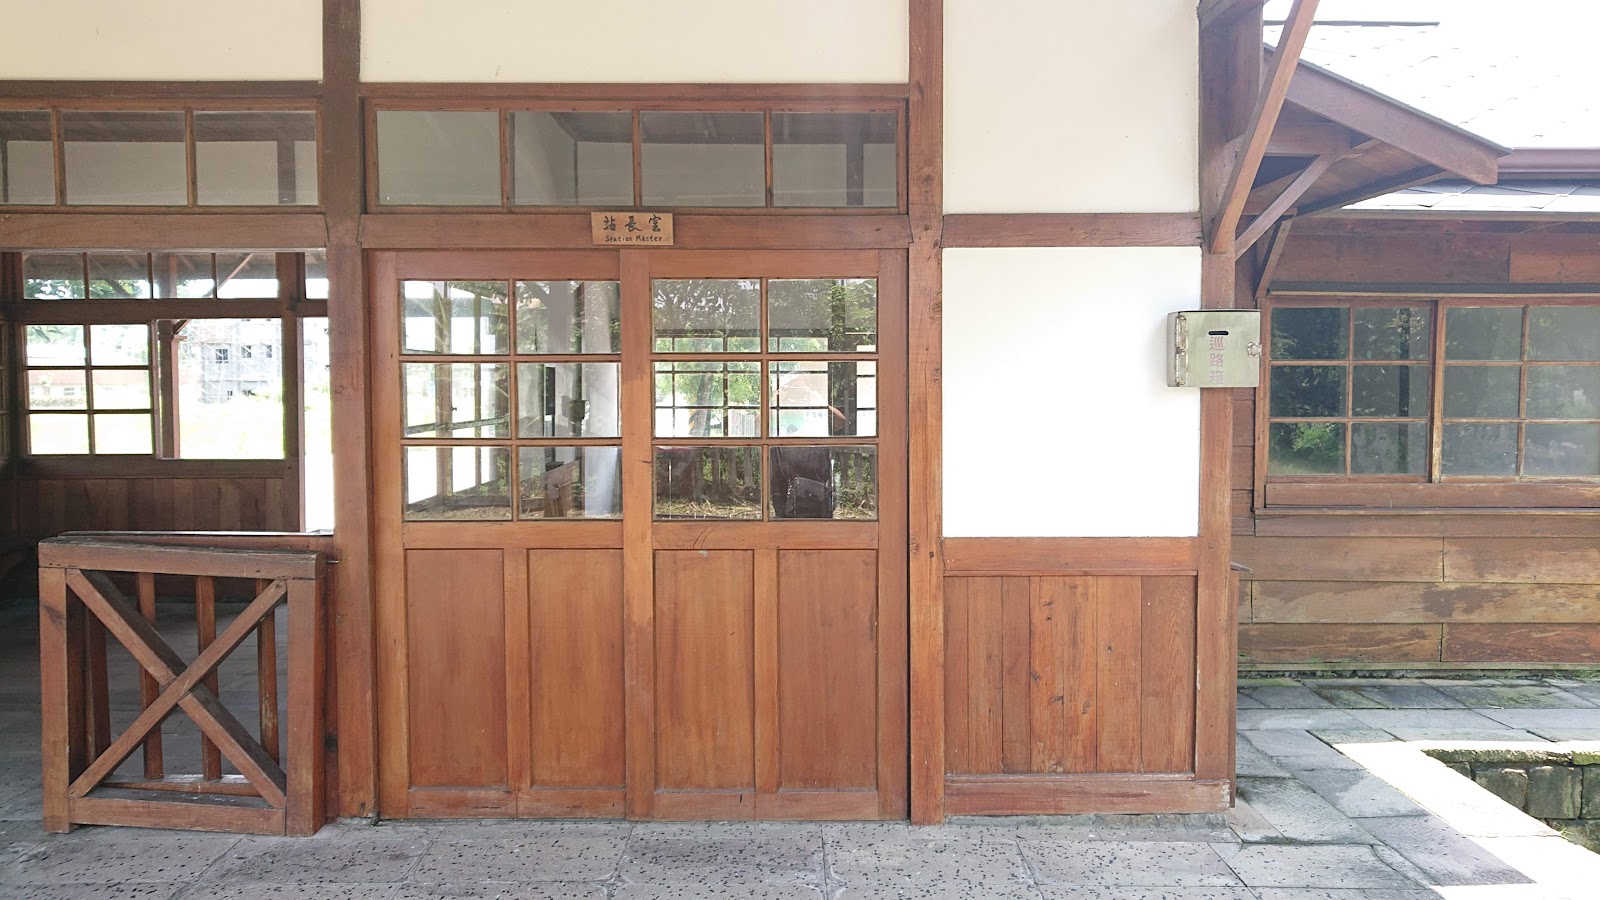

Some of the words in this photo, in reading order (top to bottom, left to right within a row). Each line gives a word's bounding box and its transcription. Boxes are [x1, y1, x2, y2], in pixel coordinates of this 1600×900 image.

[603, 214, 662, 232] 站長室
[604, 235, 633, 243] Station
[1208, 336, 1225, 385] 巡路箱
